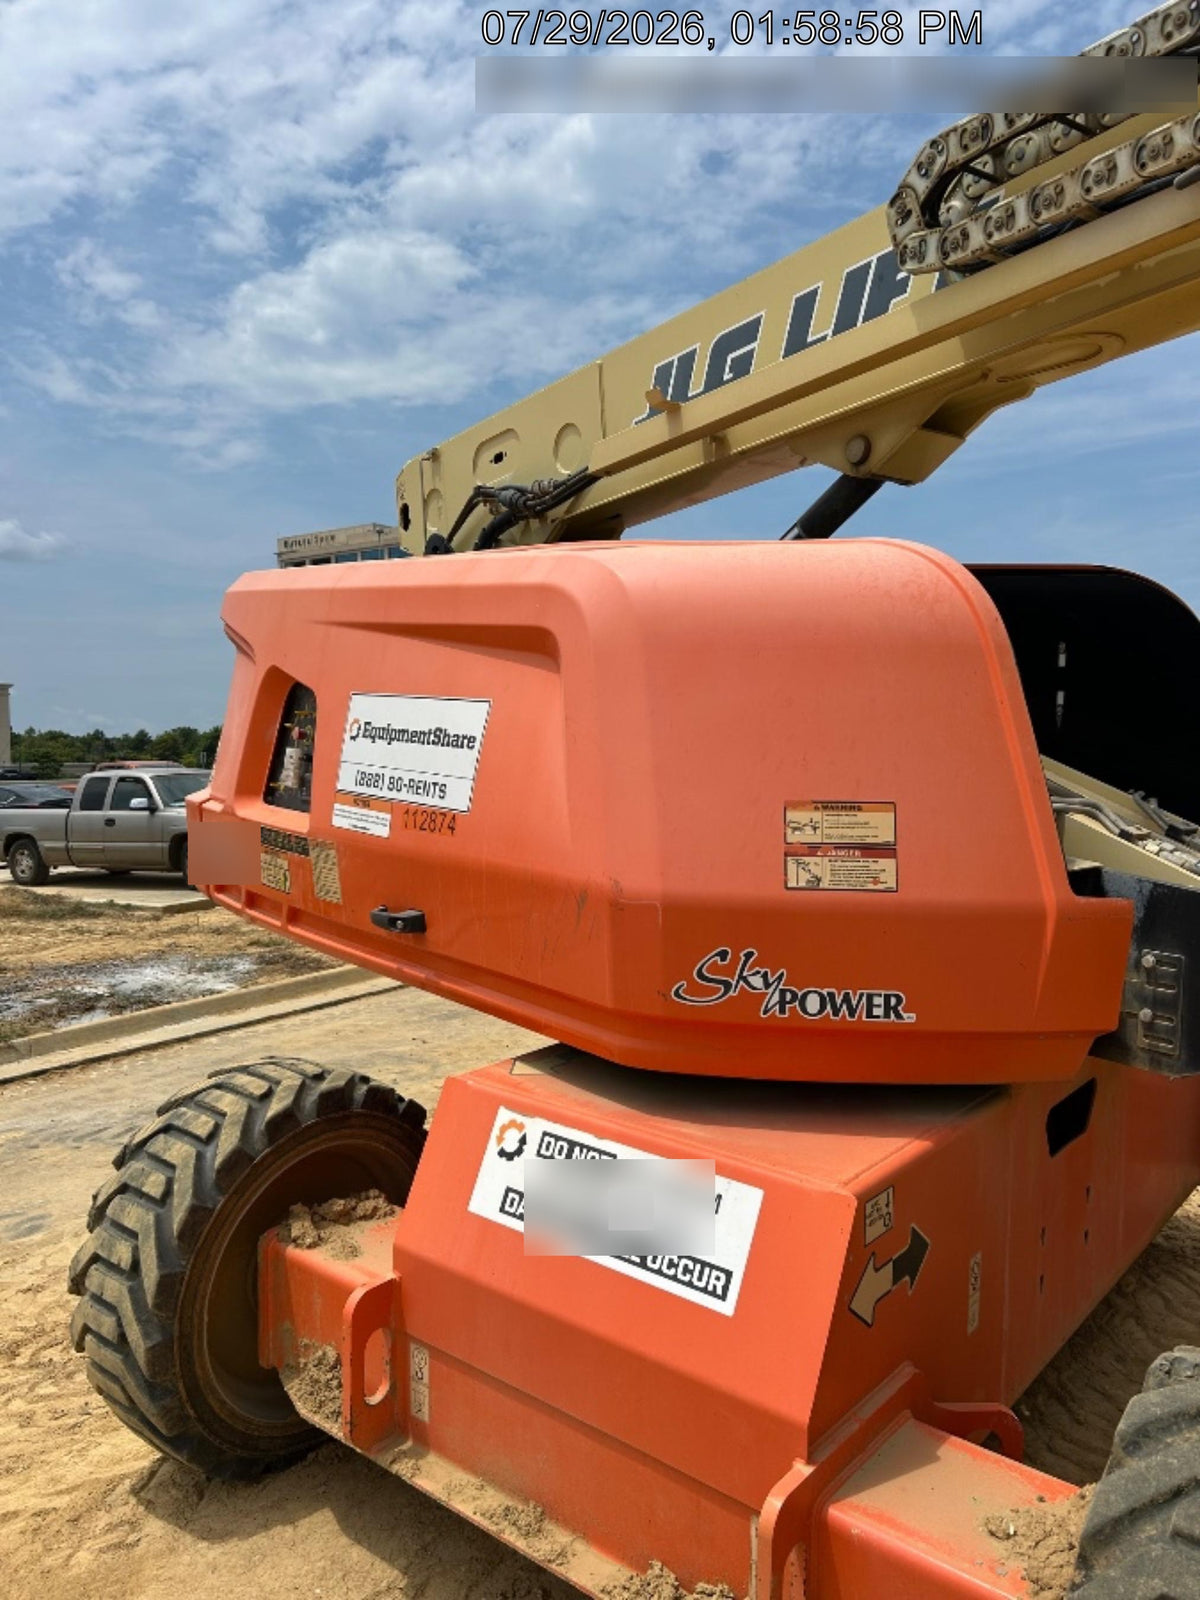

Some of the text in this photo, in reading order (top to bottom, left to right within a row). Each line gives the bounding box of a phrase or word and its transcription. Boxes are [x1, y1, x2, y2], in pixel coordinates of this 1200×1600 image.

[632, 309, 766, 427] JLG
[362, 721, 477, 750] EquipmentShare
[355, 770, 385, 791] (888)
[403, 807, 456, 836] 112874
[540, 1135, 569, 1159] DO
[646, 1256, 727, 1296] OCCUR
